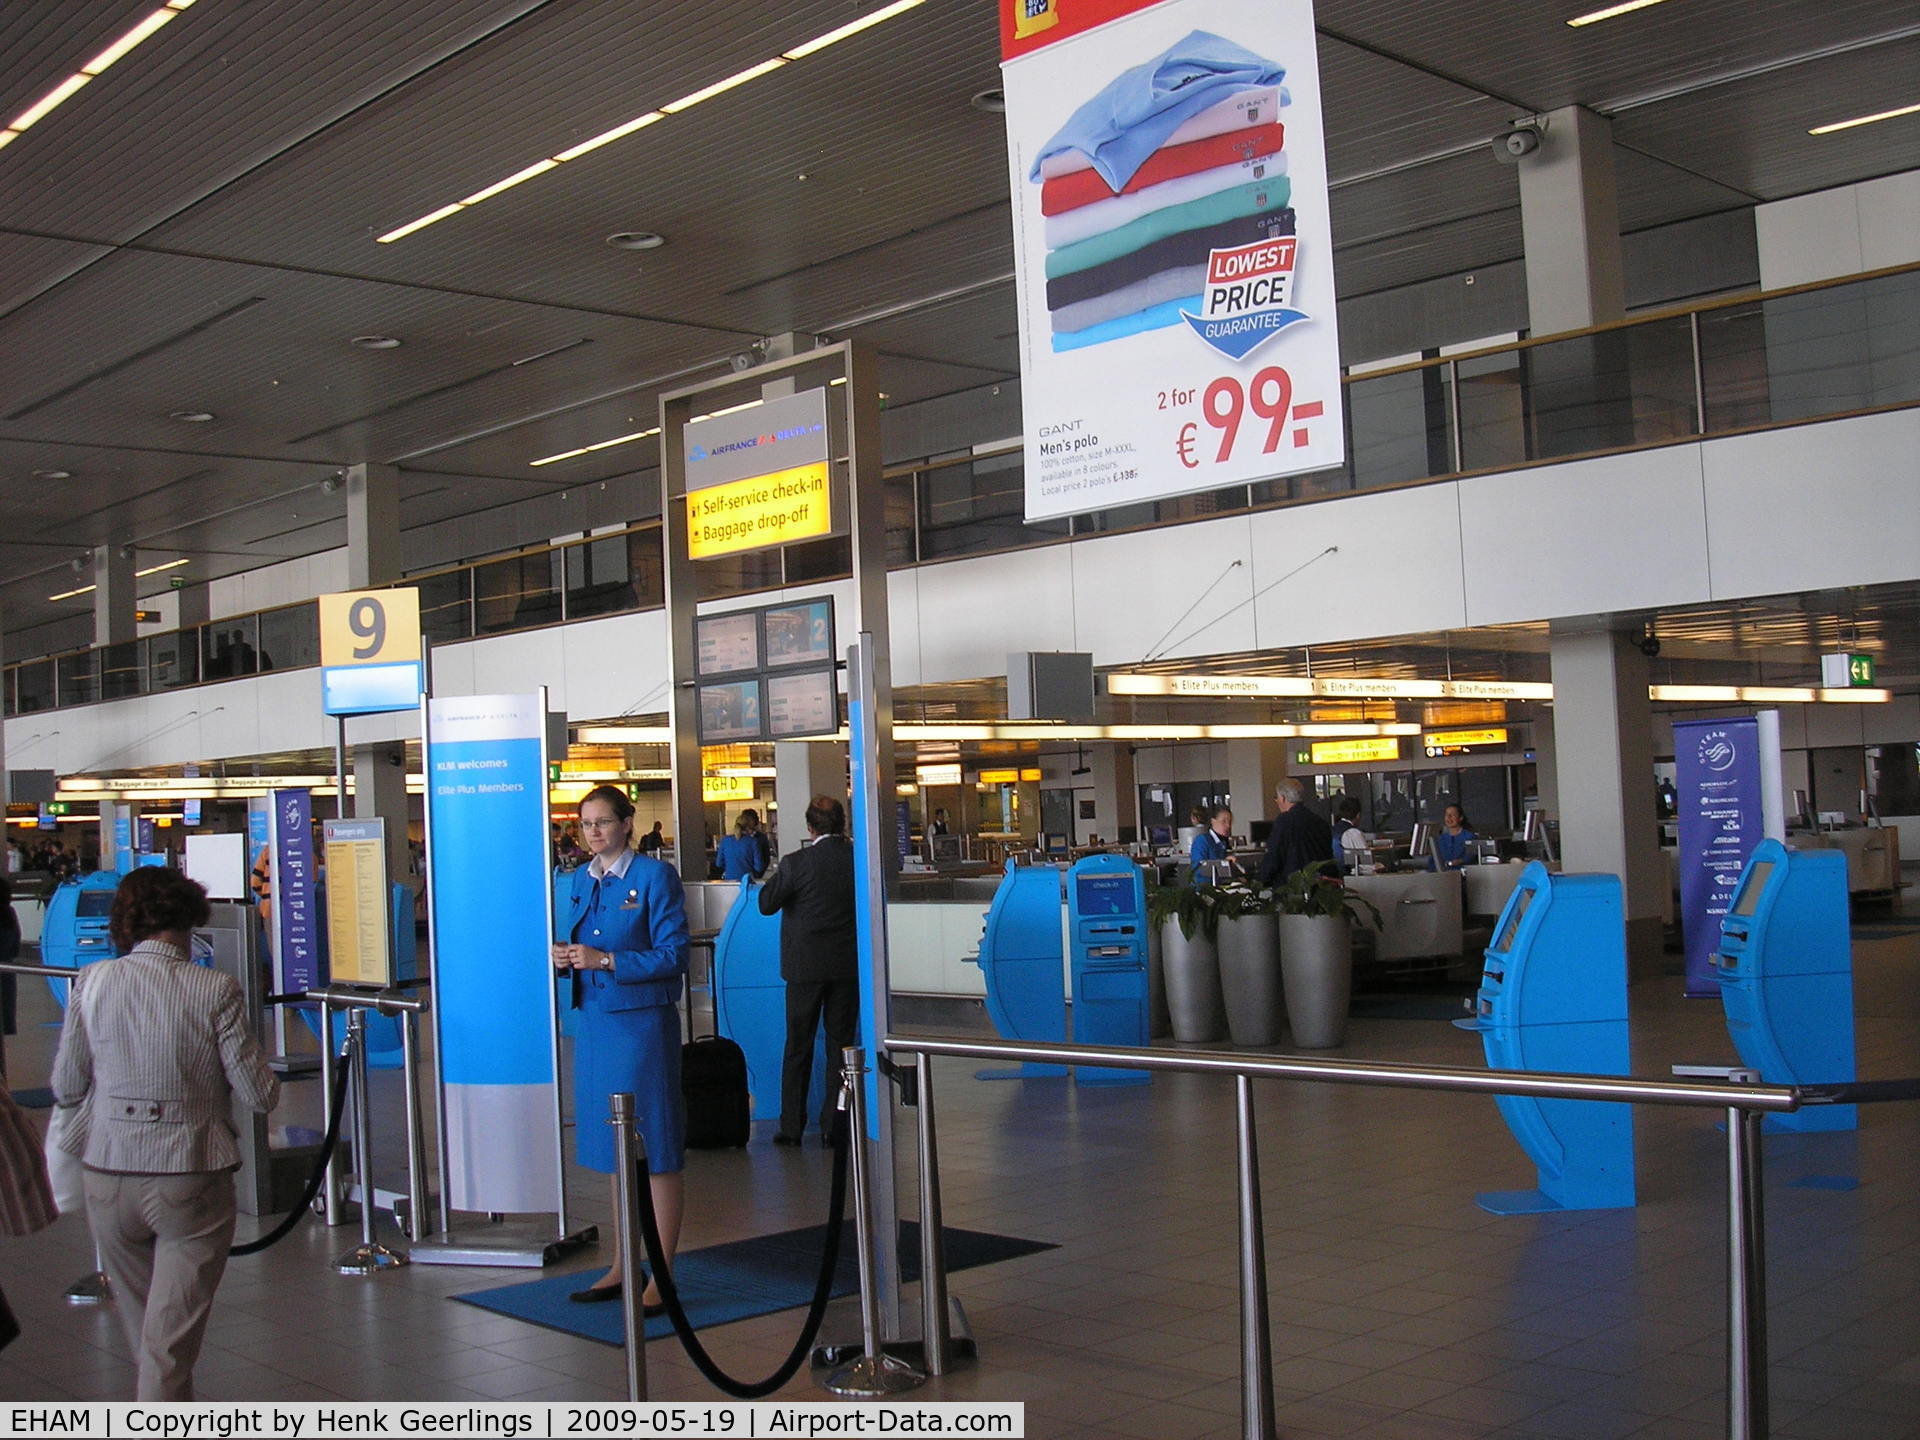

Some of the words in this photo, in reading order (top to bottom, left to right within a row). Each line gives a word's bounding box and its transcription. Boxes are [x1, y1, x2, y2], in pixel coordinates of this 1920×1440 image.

[1237, 97, 1268, 110] GANT
[1242, 154, 1273, 168] GANT
[1257, 214, 1289, 229] GANT
[1215, 245, 1290, 278] LOWEST
[1210, 276, 1286, 315] PRICE
[1205, 312, 1281, 338] GUARANTEE
[1157, 392, 1167, 410] 2
[1172, 387, 1196, 407] for
[1039, 419, 1084, 438] GANT
[1040, 440, 1071, 456] Men's
[1074, 434, 1098, 452] polo
[1176, 422, 1200, 468] €
[1041, 469, 1072, 482] available
[703, 493, 769, 515] Self-service
[772, 475, 823, 500] check-in
[1041, 485, 1061, 496] Local
[1063, 481, 1081, 492] price
[703, 519, 754, 542] Baggage
[758, 504, 809, 530] drop-off
[349, 597, 386, 659] 9
[1182, 680, 1201, 690] Elite
[1203, 680, 1220, 690] Plus
[1222, 681, 1259, 691] members
[457, 759, 508, 769] welcomes
[438, 785, 455, 795] Elite
[457, 785, 475, 794] Plus
[478, 783, 524, 793] Members
